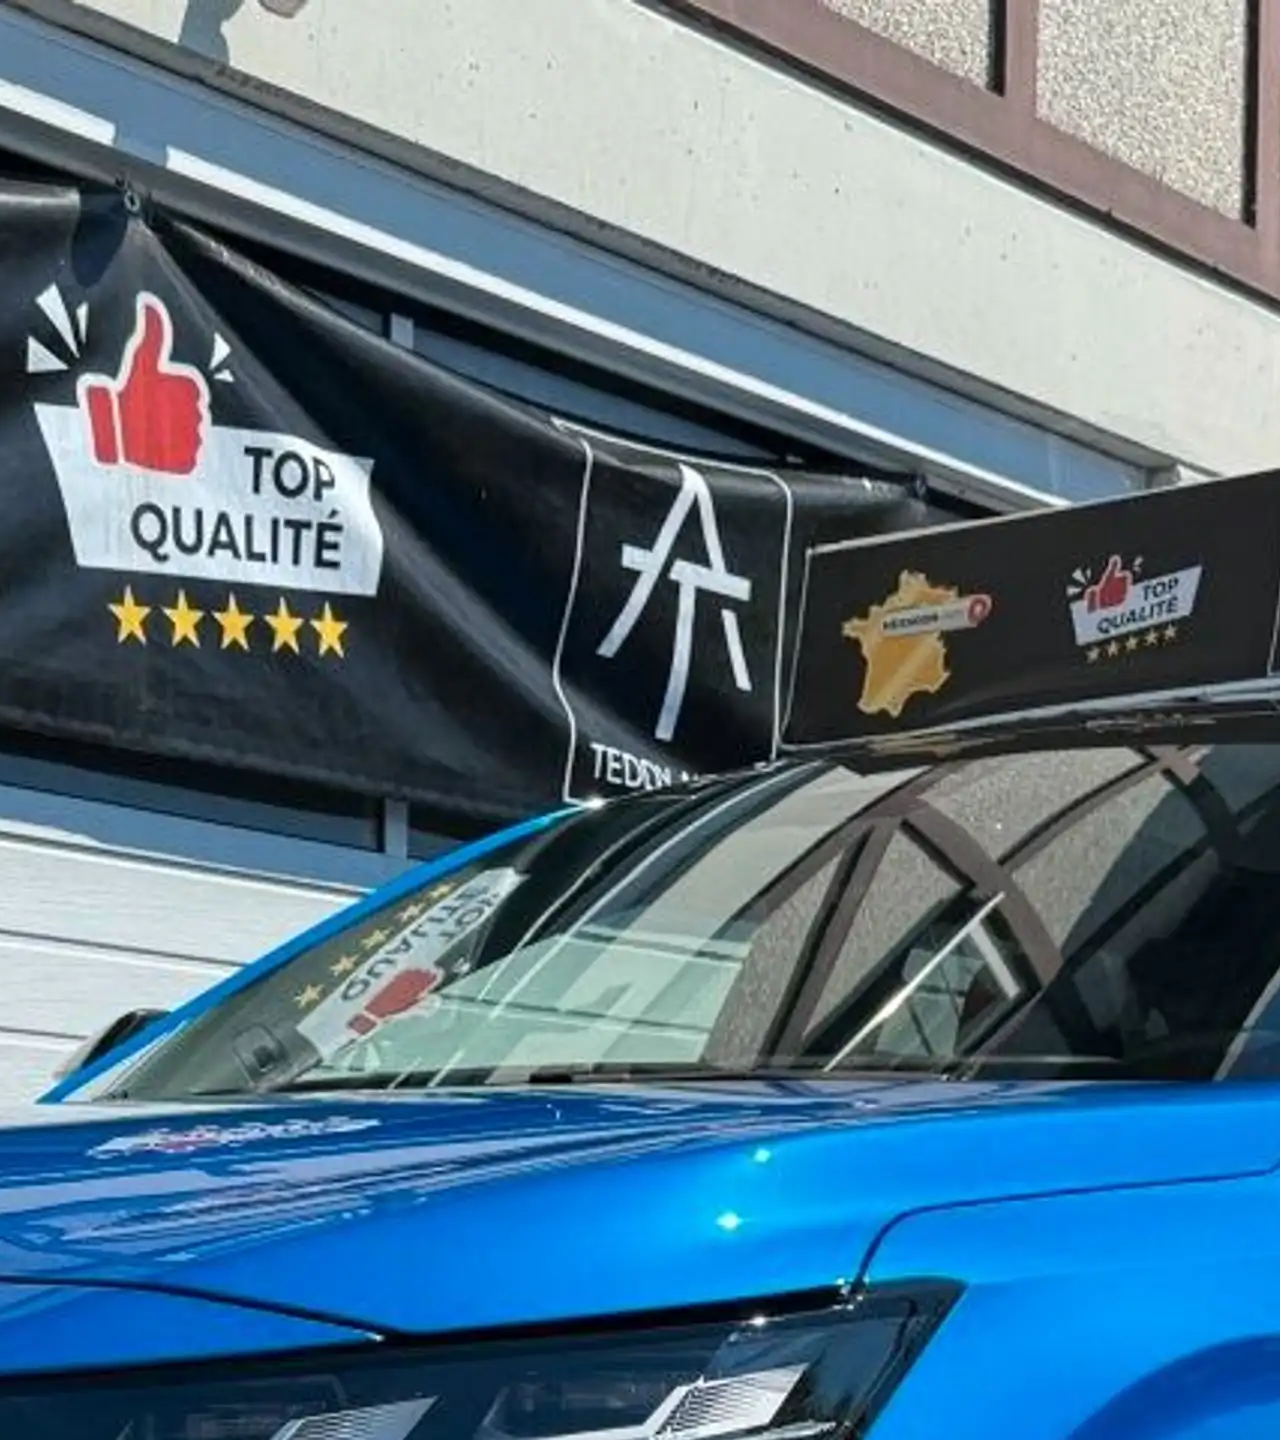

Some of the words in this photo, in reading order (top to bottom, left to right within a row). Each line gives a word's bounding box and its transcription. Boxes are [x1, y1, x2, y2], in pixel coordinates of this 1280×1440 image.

[244, 445, 335, 501] TOP
[130, 502, 344, 570] QUALITÉ
[1143, 577, 1179, 601] TOP
[1096, 597, 1178, 634] QUALITÉ
